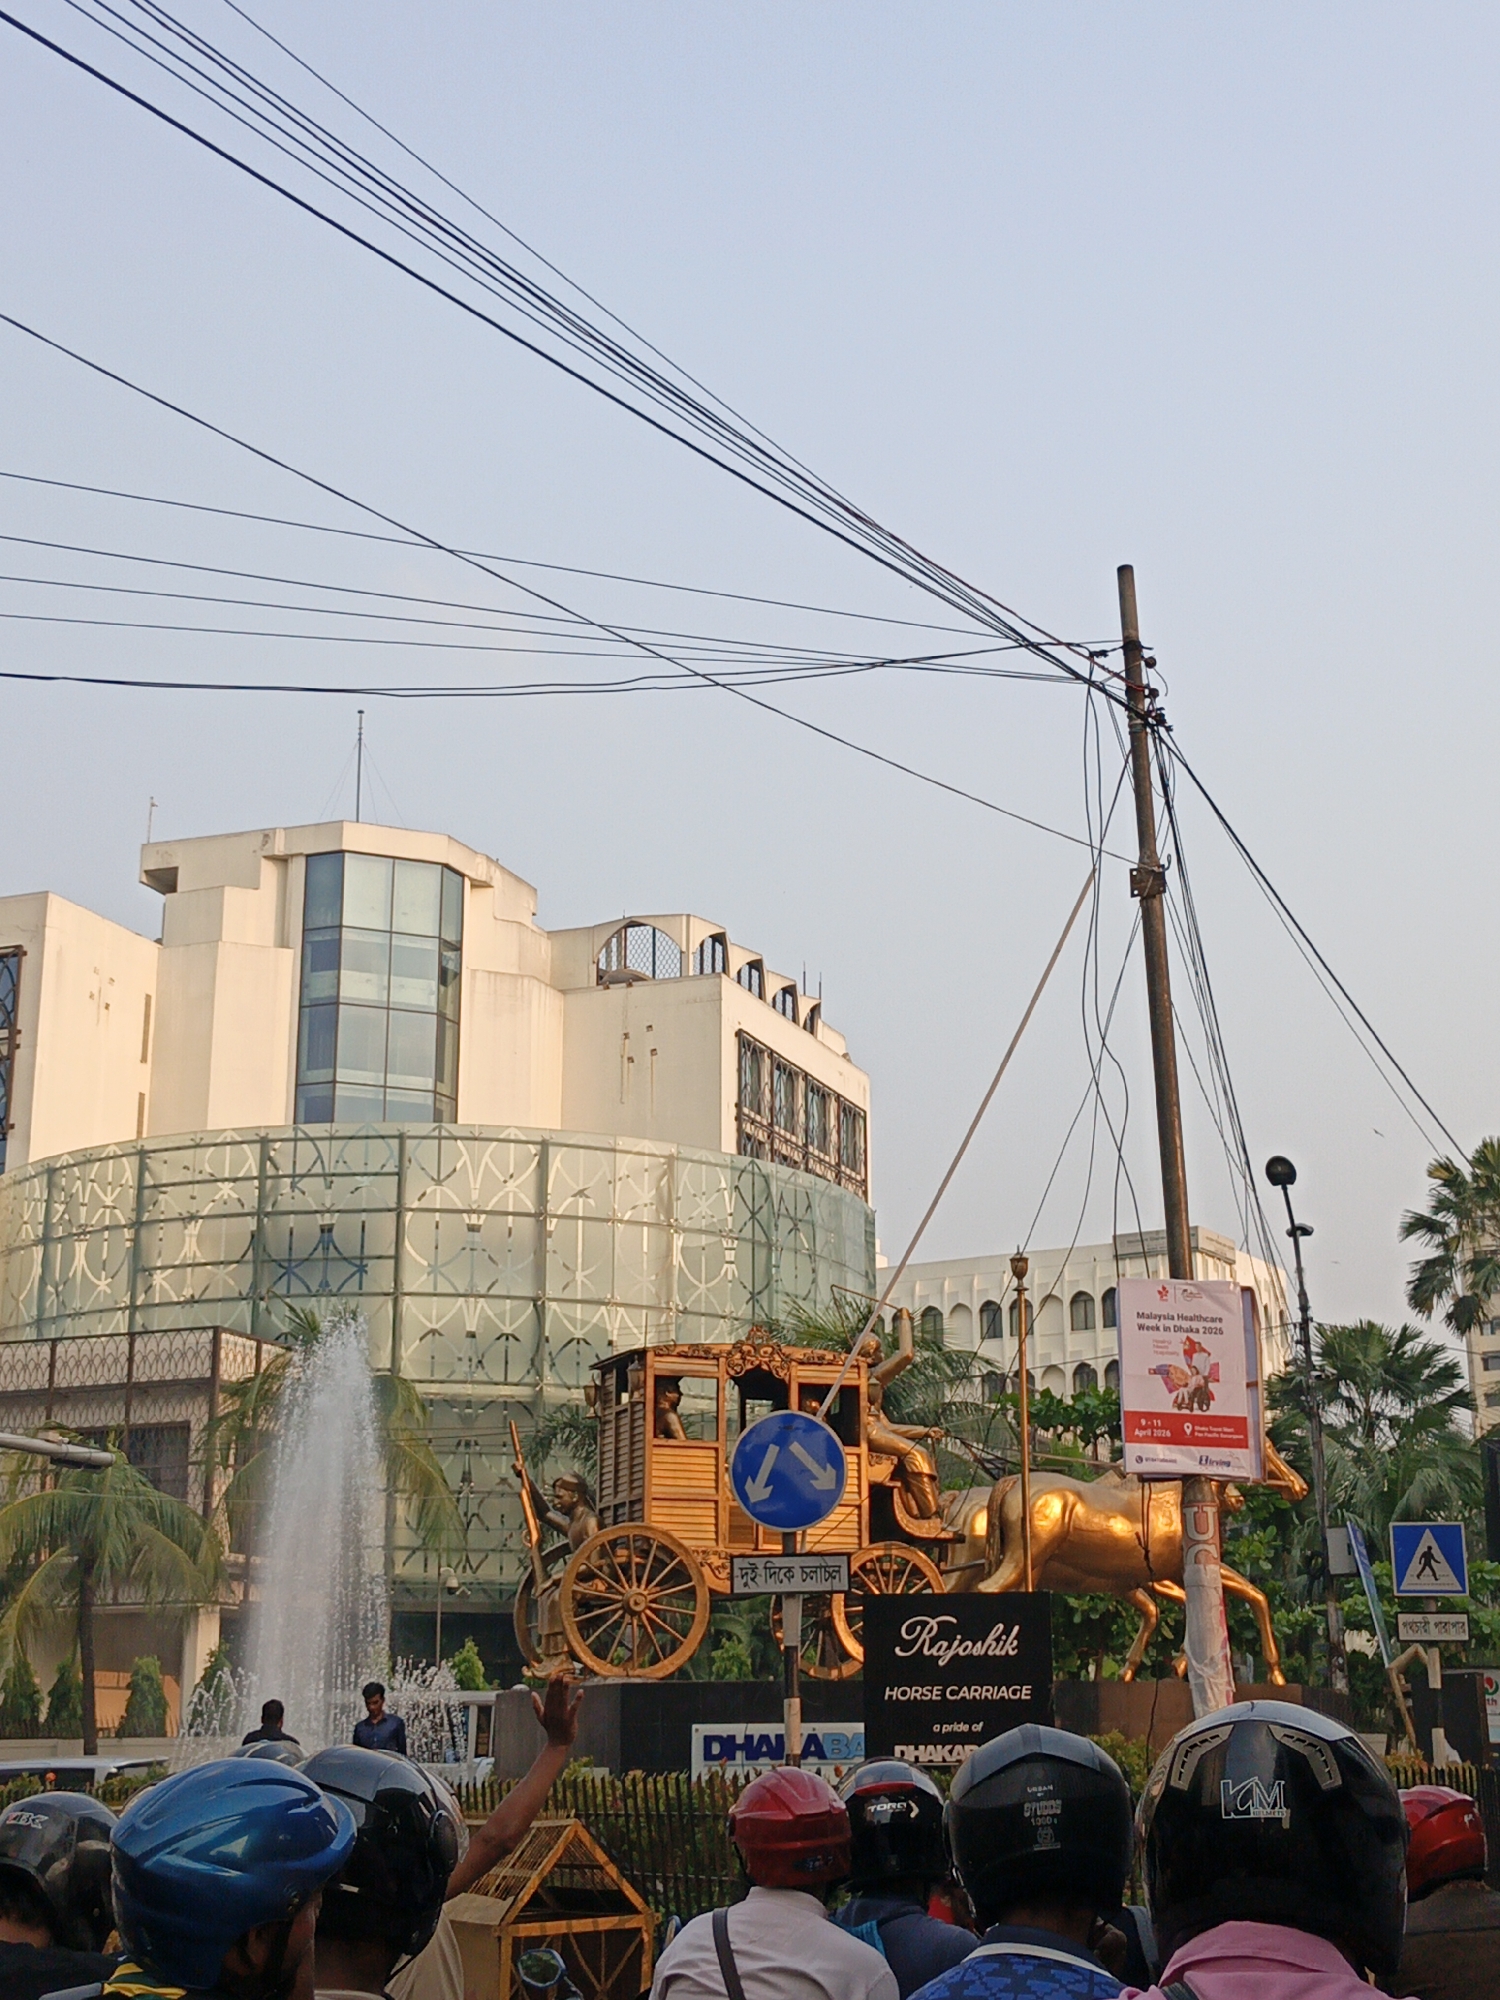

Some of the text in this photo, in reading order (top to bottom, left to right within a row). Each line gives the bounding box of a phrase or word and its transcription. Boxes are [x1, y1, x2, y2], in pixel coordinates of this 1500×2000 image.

[1136, 1311, 1223, 1323] Malaysia Healthcare
[1137, 1323, 1224, 1335] Week in Dhaka 2026
[1140, 1418, 1146, 1426] 9
[1153, 1419, 1162, 1427] 11
[1134, 1428, 1171, 1438] April 2026
[739, 1561, 841, 1589] দুই দিকে চলাচল
[1434, 1620, 1466, 1635] পারাপার
[894, 1615, 1020, 1667] Rajoshik
[884, 1685, 1032, 1700] HORSE CARRIAGE
[932, 1721, 984, 1734] a pride of
